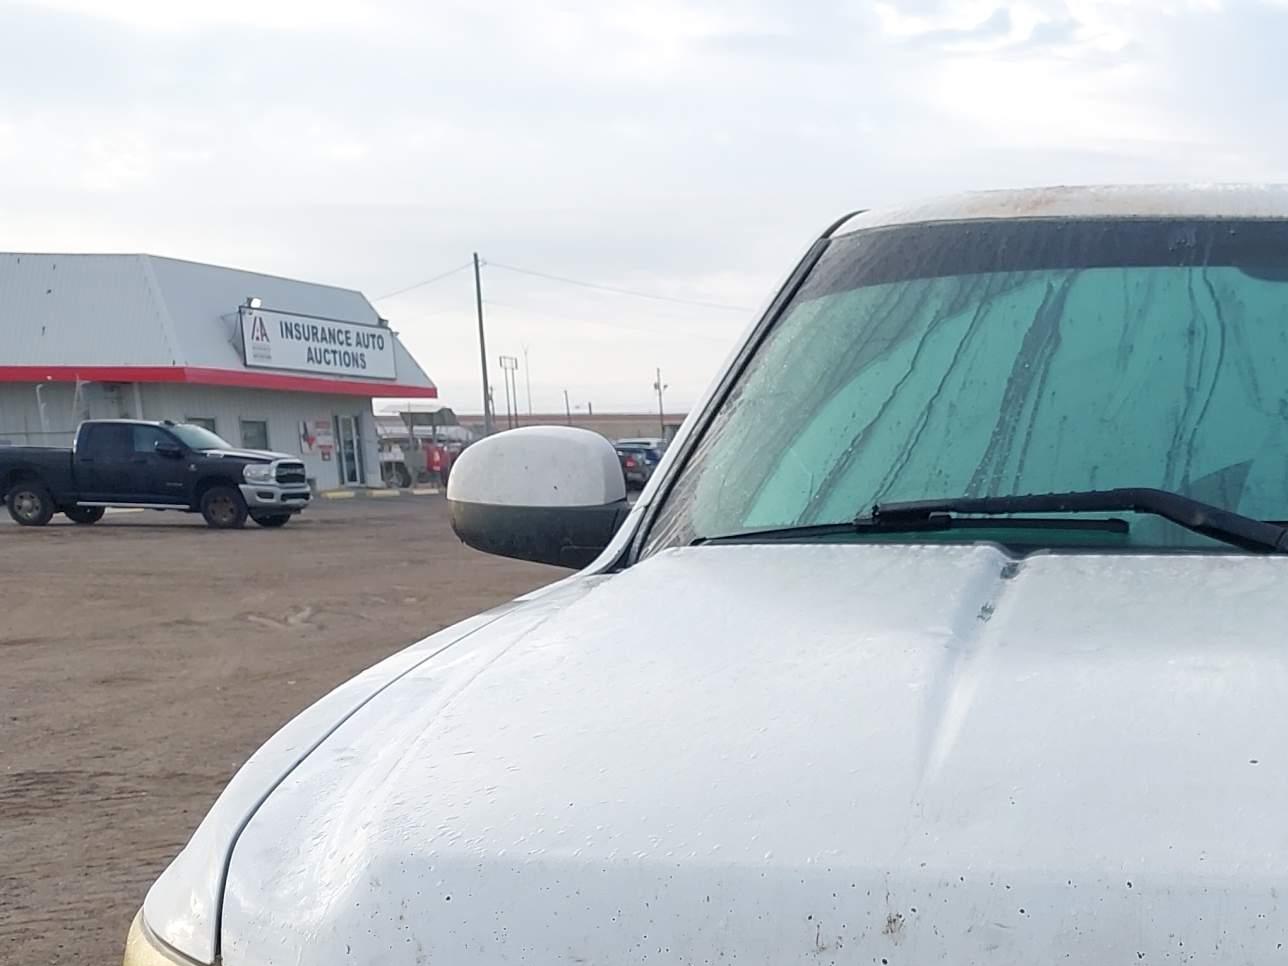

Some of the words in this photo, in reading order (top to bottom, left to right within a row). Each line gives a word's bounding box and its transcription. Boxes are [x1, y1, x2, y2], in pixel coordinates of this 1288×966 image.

[279, 321, 353, 347] INSURANCE
[355, 332, 385, 351] AUTO
[306, 347, 366, 369] AUCTIONS
